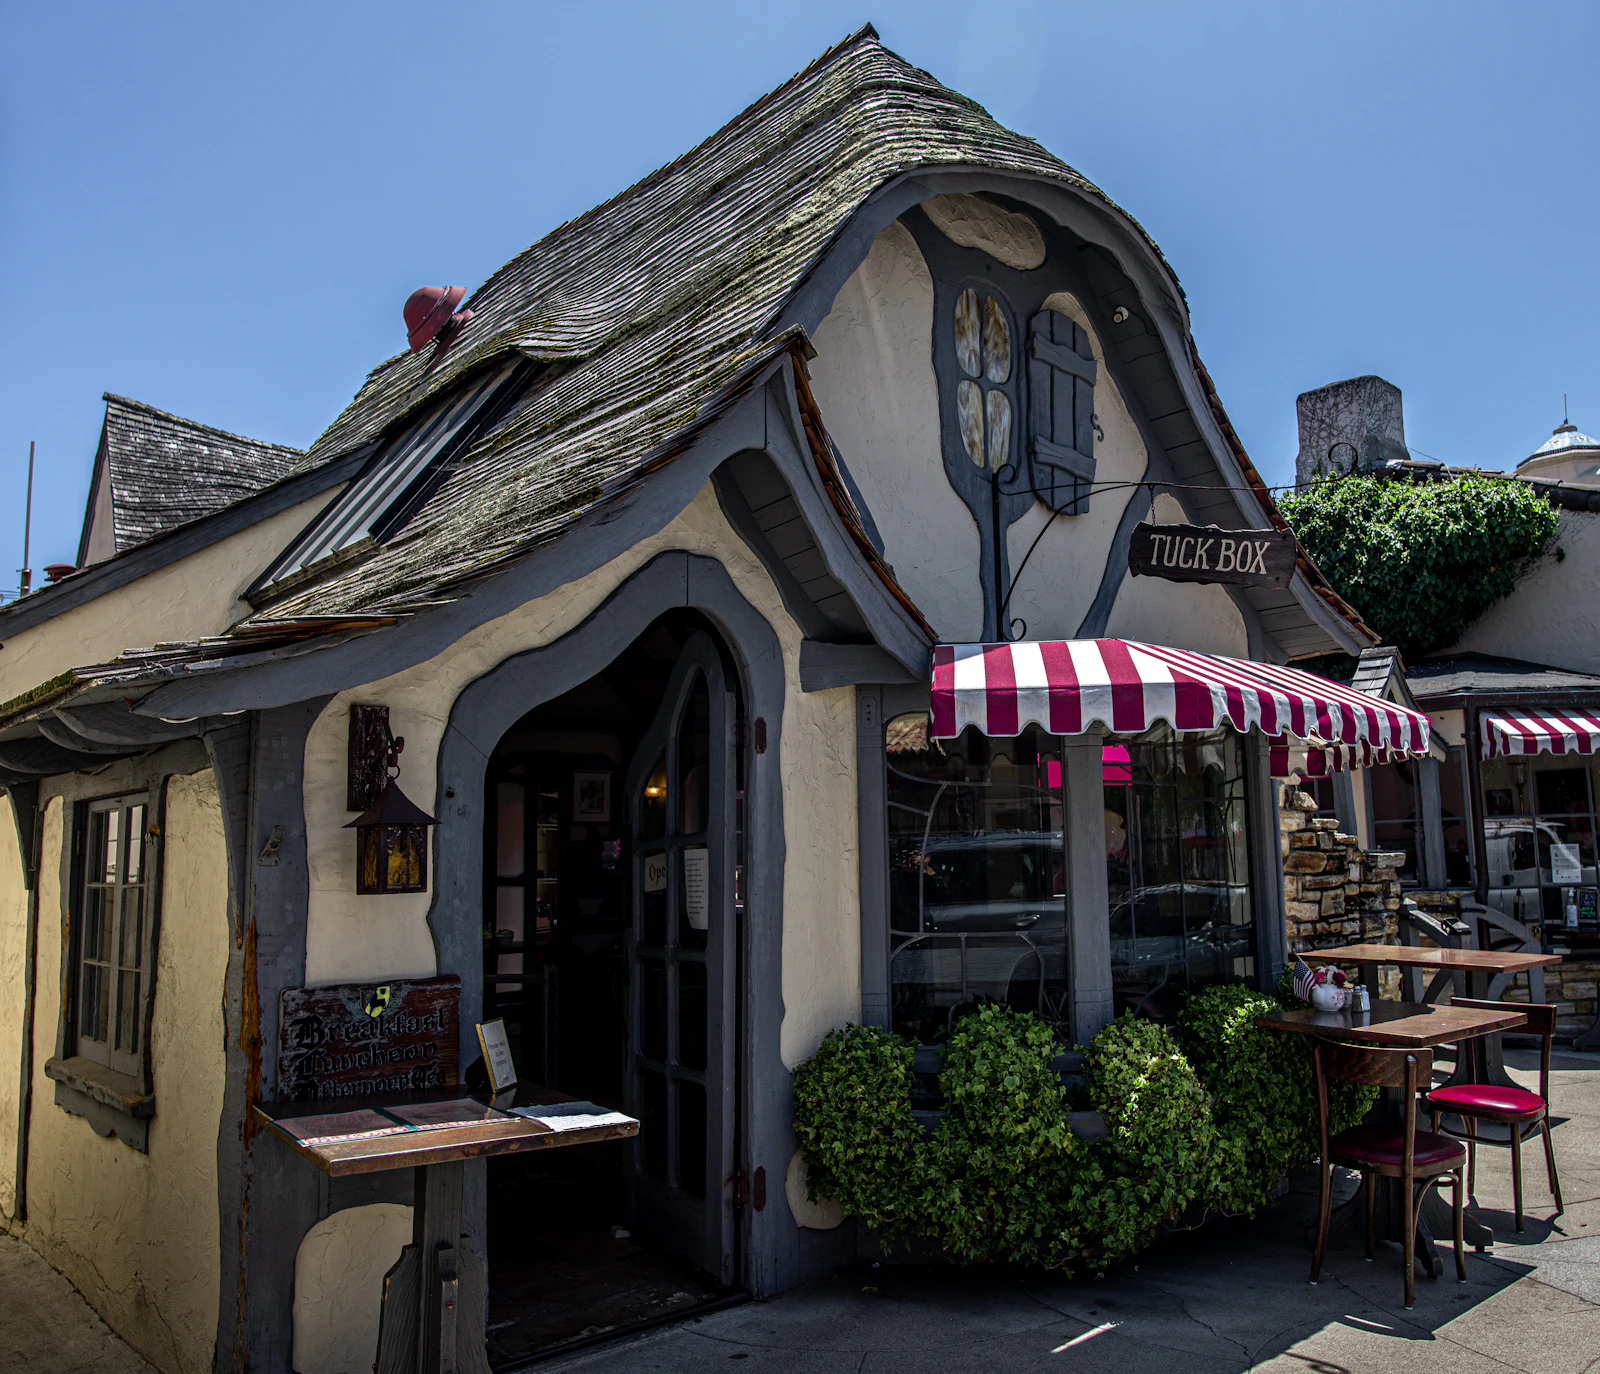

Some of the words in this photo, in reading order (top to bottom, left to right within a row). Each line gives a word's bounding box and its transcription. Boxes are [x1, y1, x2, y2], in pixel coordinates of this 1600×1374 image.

[1150, 534, 1214, 570] TUCK
[1215, 538, 1271, 575] BOX
[649, 864, 667, 885] Ope
[288, 1007, 447, 1050] Breakfast
[289, 1042, 438, 1081] Luncheon
[290, 1073, 409, 1101] Afternoon
[410, 1061, 447, 1089] Tea
